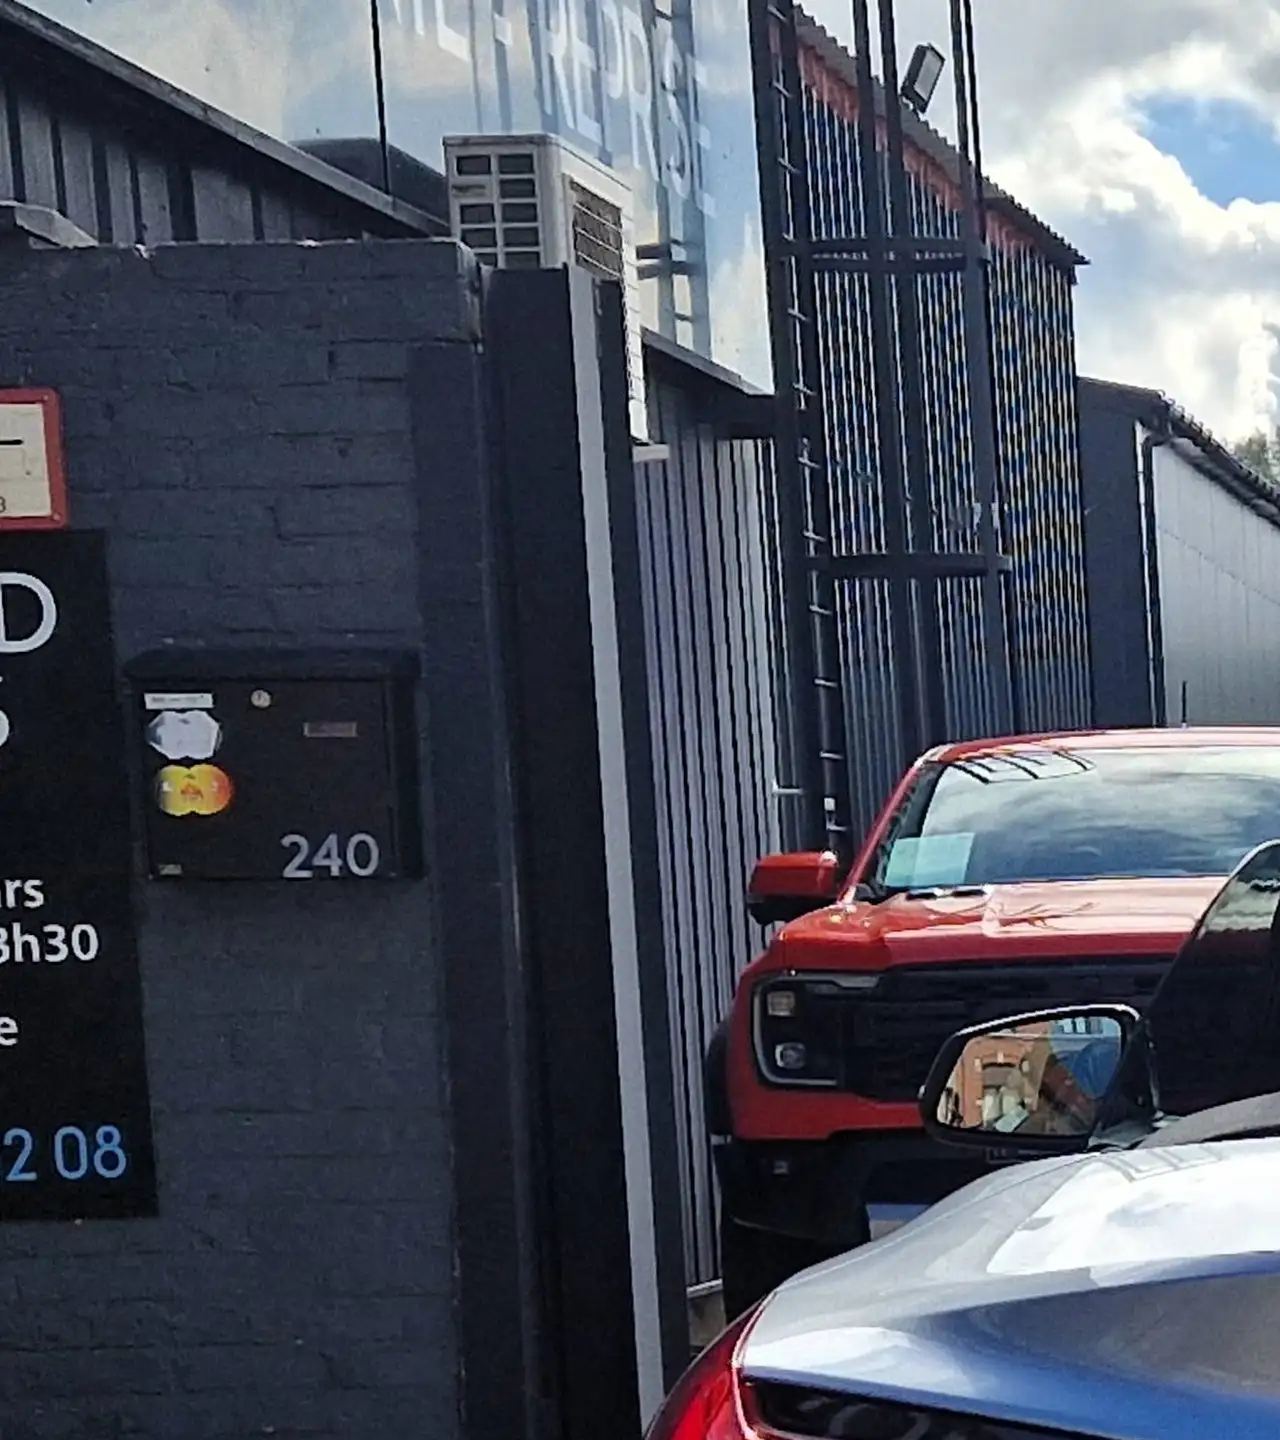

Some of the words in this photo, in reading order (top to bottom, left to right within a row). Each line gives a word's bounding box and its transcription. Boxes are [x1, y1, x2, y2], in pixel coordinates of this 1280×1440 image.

[280, 833, 380, 879] 240
[0, 879, 45, 909] rs
[54, 1125, 127, 1180] 08
